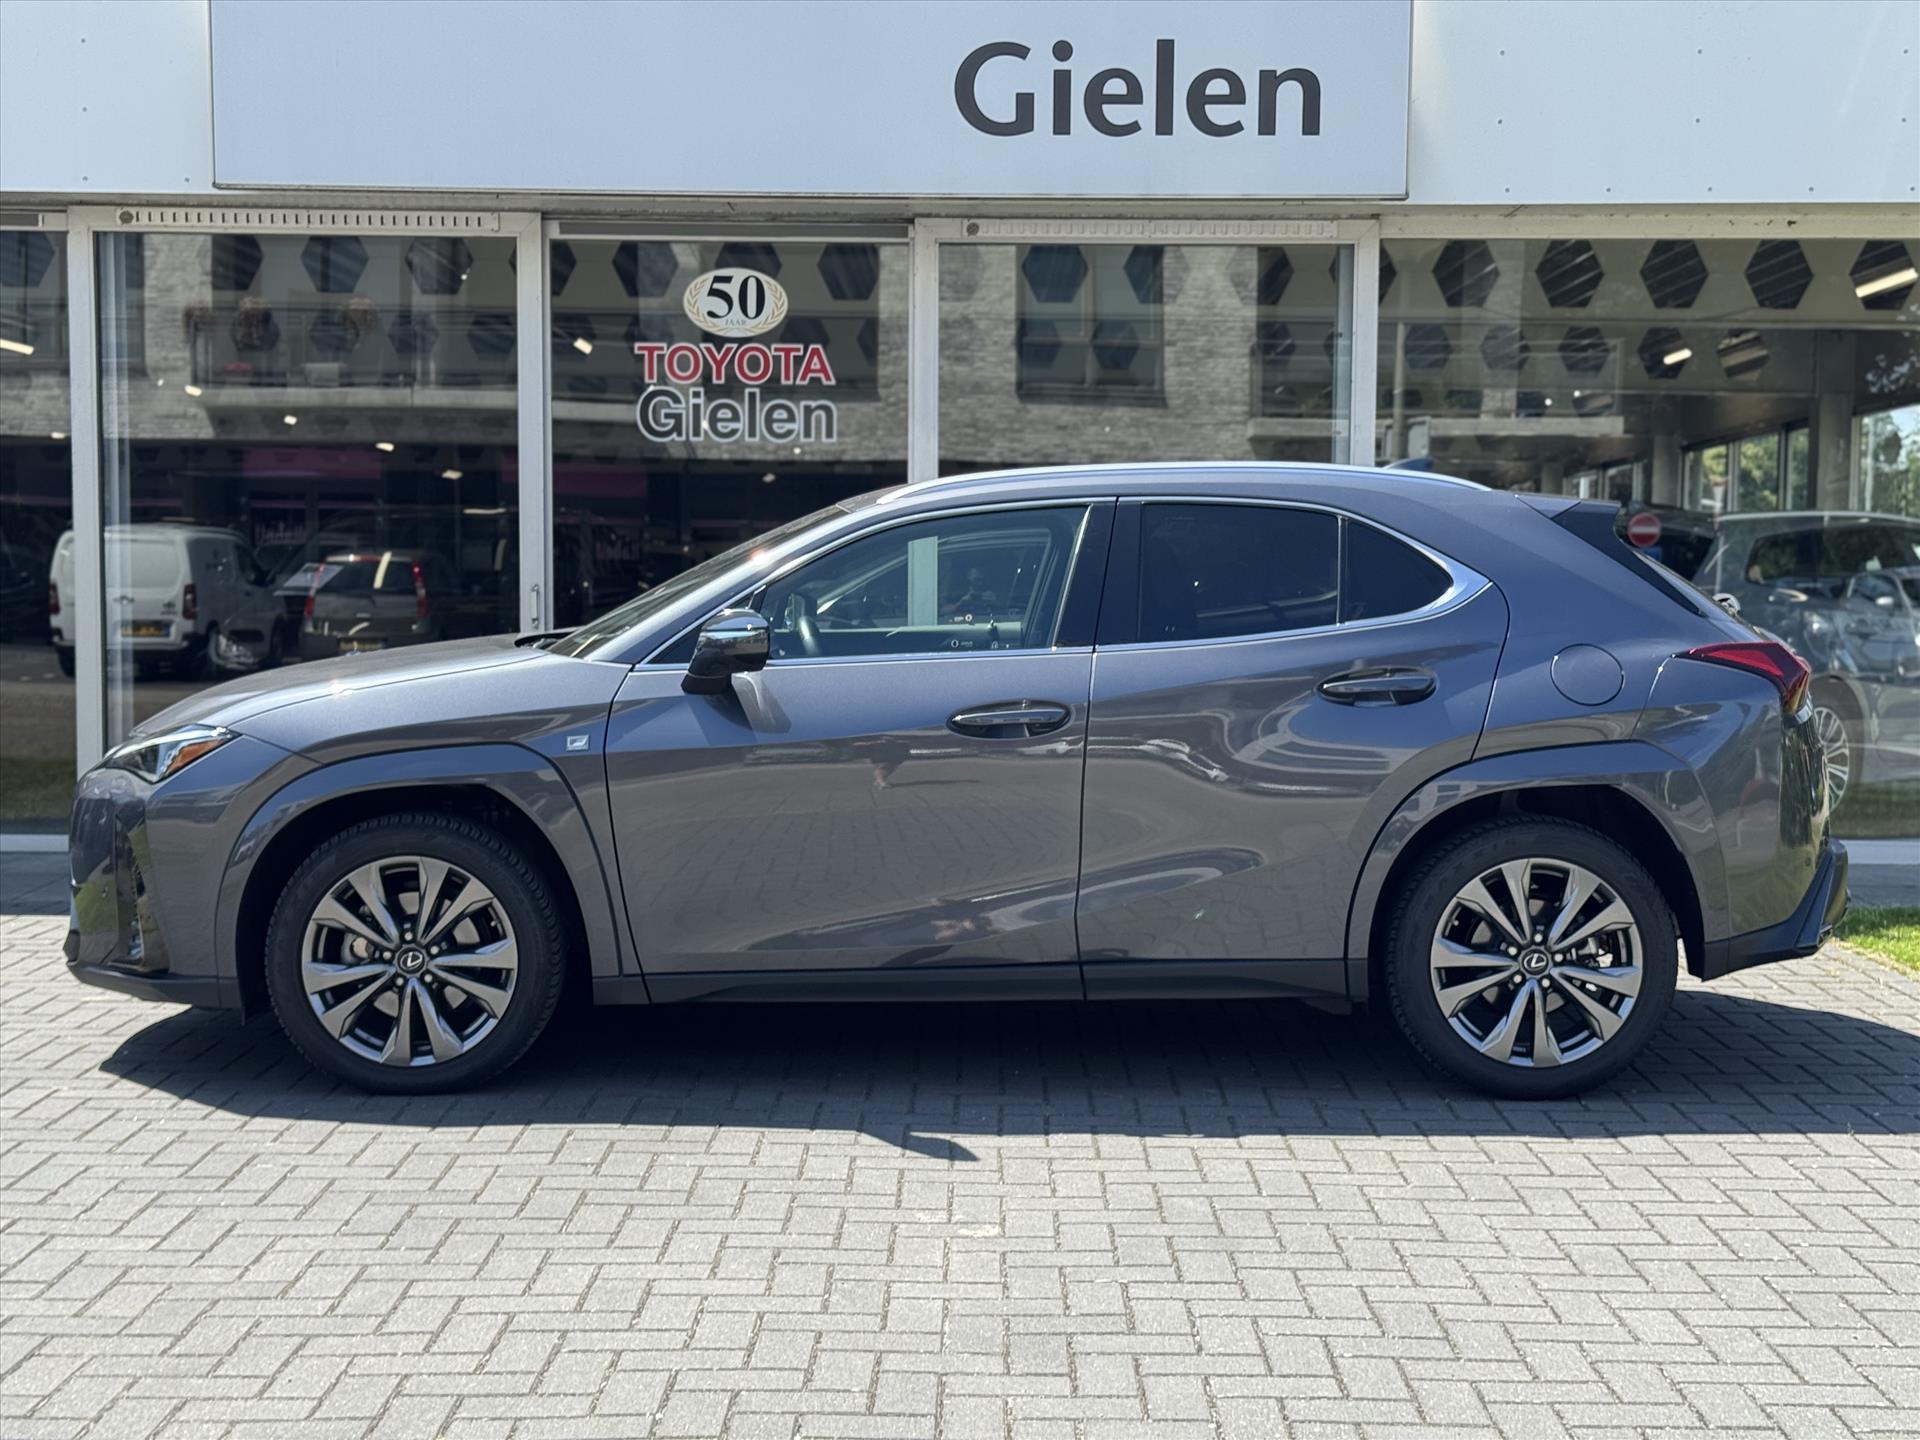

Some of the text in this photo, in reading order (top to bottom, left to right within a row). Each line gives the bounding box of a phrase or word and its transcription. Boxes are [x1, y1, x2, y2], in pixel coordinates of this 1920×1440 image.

[954, 38, 1321, 137] Gielen
[706, 275, 766, 320] 50
[725, 318, 748, 327] JAAR
[634, 342, 836, 385] TOYOTA
[636, 385, 837, 442] Gielen
